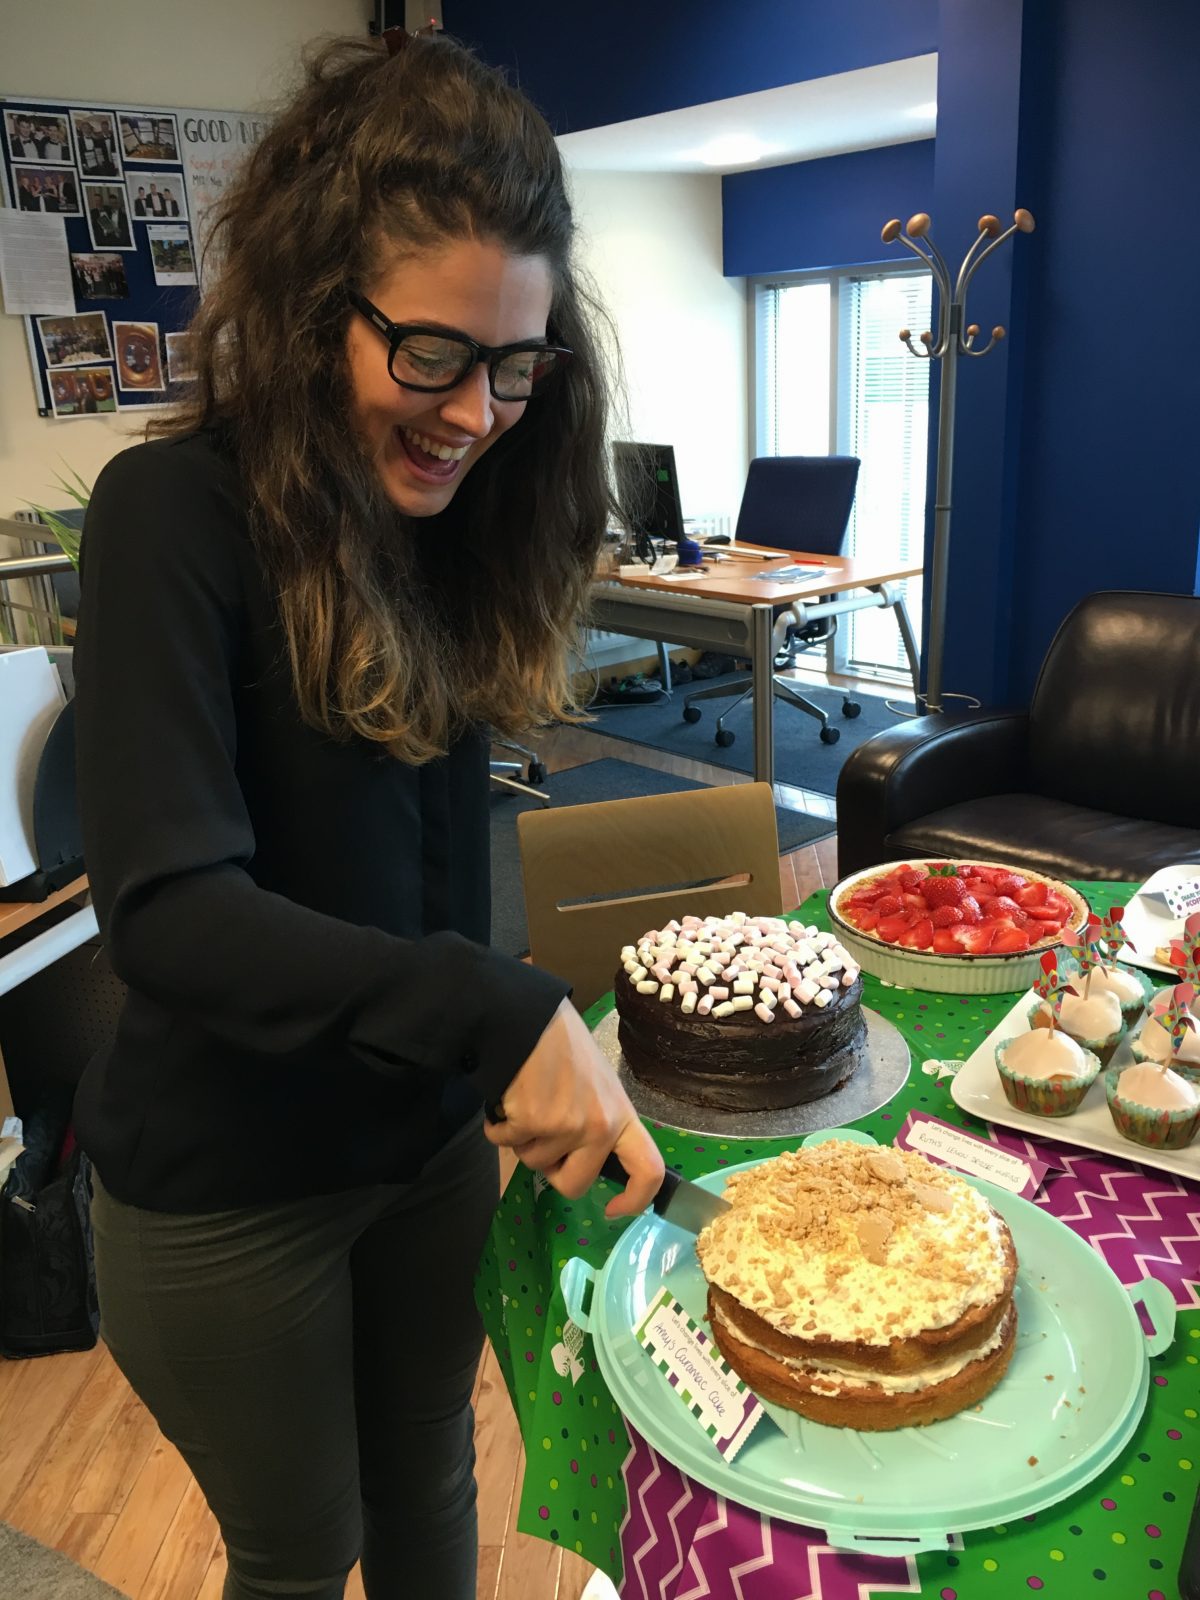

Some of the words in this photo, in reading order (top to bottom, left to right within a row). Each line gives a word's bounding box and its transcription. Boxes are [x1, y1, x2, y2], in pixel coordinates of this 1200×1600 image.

[183, 118, 232, 143] GOOD
[238, 121, 263, 144] NE
[931, 1124, 942, 1133] Let's
[943, 1130, 960, 1141] change
[962, 1137, 972, 1145] lives
[973, 1142, 983, 1150] with
[984, 1148, 998, 1157] every
[998, 1153, 1011, 1162] slice
[653, 1323, 676, 1350] Amy's
[675, 1347, 708, 1390] Caramac
[708, 1391, 726, 1417] Cake
[672, 1317, 680, 1328] Let's
[680, 1327, 694, 1346] change
[693, 1344, 702, 1356] lives
[702, 1355, 711, 1366] with
[711, 1365, 722, 1380] every
[721, 1376, 731, 1392] slice
